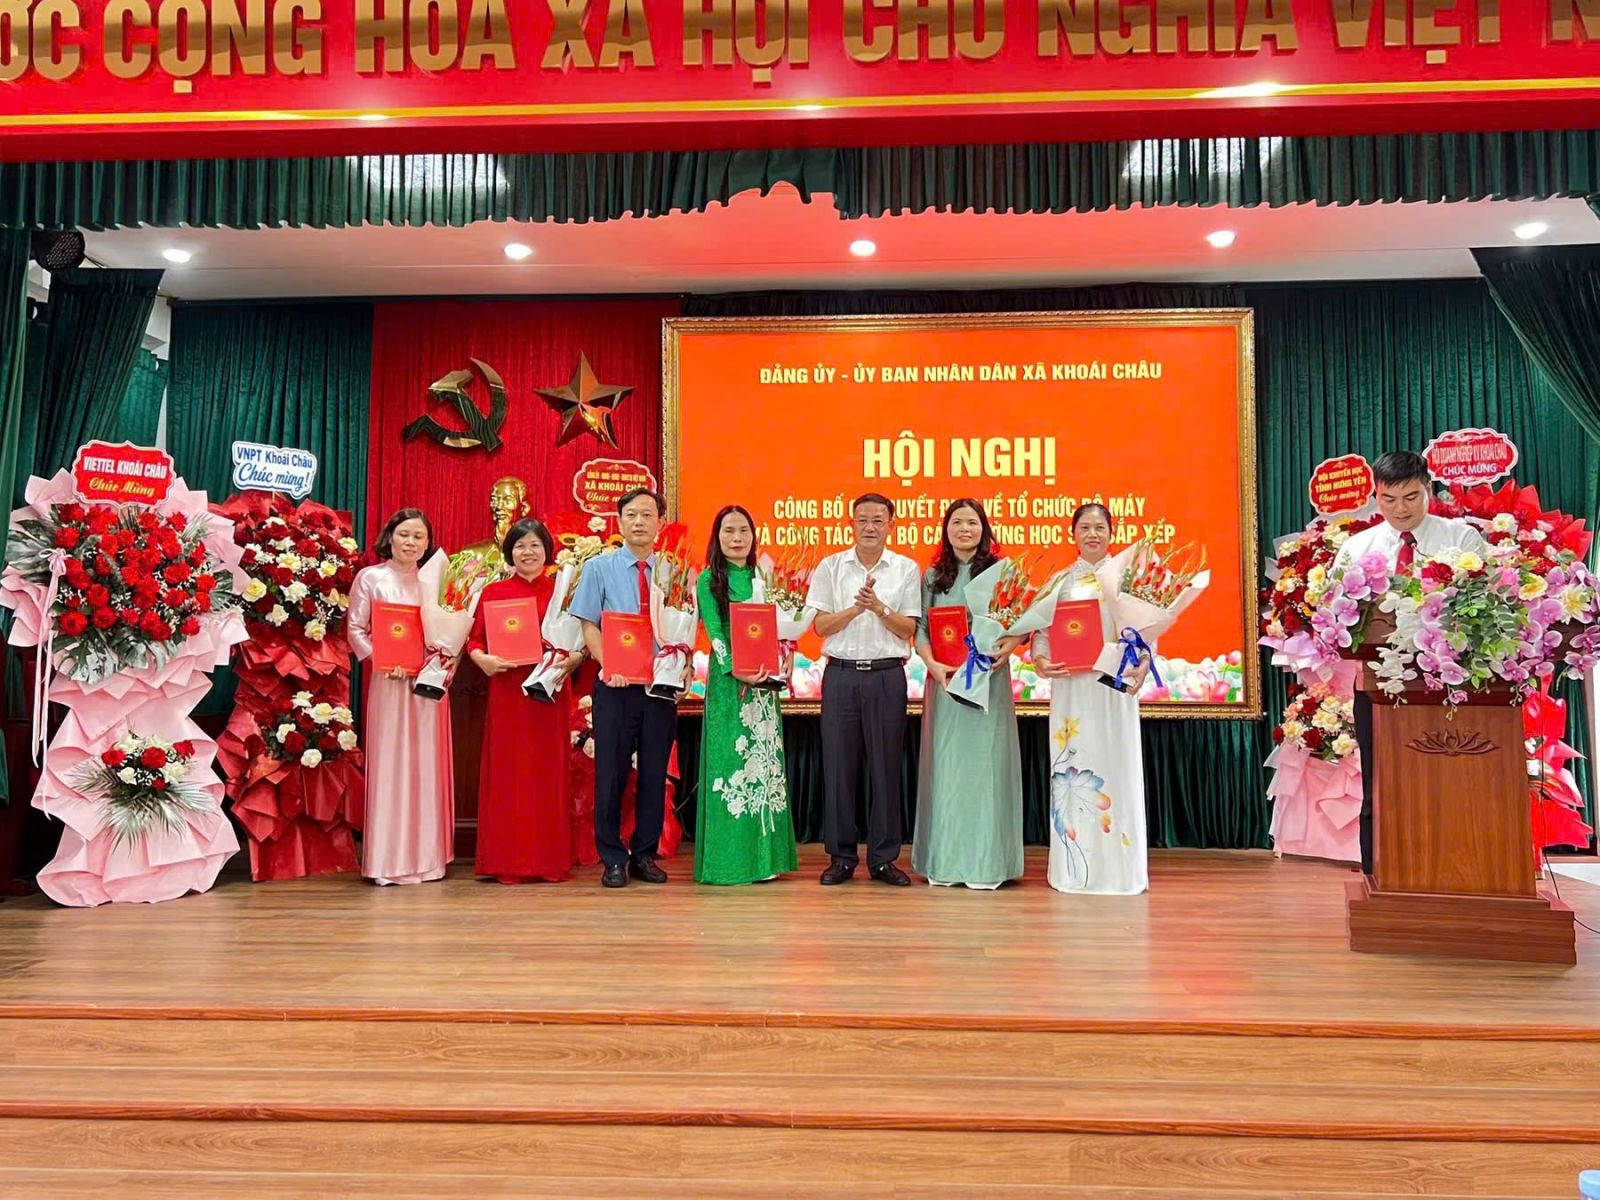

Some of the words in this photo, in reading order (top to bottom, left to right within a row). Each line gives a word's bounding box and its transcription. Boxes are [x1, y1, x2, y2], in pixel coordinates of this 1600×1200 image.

[760, 363, 808, 383] ĐẢNG
[813, 362, 836, 383] ỦY
[853, 362, 876, 382] ỦY
[881, 367, 918, 382] BAN
[924, 363, 974, 382] NHÂN
[979, 362, 1016, 381] DÂN
[1023, 362, 1047, 380] XÃ
[1052, 361, 1106, 380] KHOÁI
[1112, 360, 1162, 379] CHÂU
[83, 456, 115, 474] VIETTEL
[116, 459, 143, 476] KHOÁI
[237, 446, 262, 461] VNPT
[265, 450, 290, 466] Khoái
[292, 454, 313, 468] Châu
[863, 430, 935, 486] HỘI
[951, 437, 1056, 485] NGHỊ
[239, 462, 273, 482] Chúc
[1442, 463, 1466, 476] CHÚC
[598, 481, 623, 491] KHOÁI
[774, 495, 818, 519] CÔNG
[822, 493, 844, 519] BỐ
[892, 493, 935, 519] UYẾT
[1008, 491, 1028, 518] TỔ
[1032, 494, 1076, 518] CHỨC
[1109, 493, 1146, 517] MÁY
[775, 522, 819, 546] CÔNG
[824, 522, 853, 545] TÁC
[897, 522, 918, 549] BỘ
[923, 521, 943, 545] CÁ
[1029, 525, 1063, 549] HỌC
